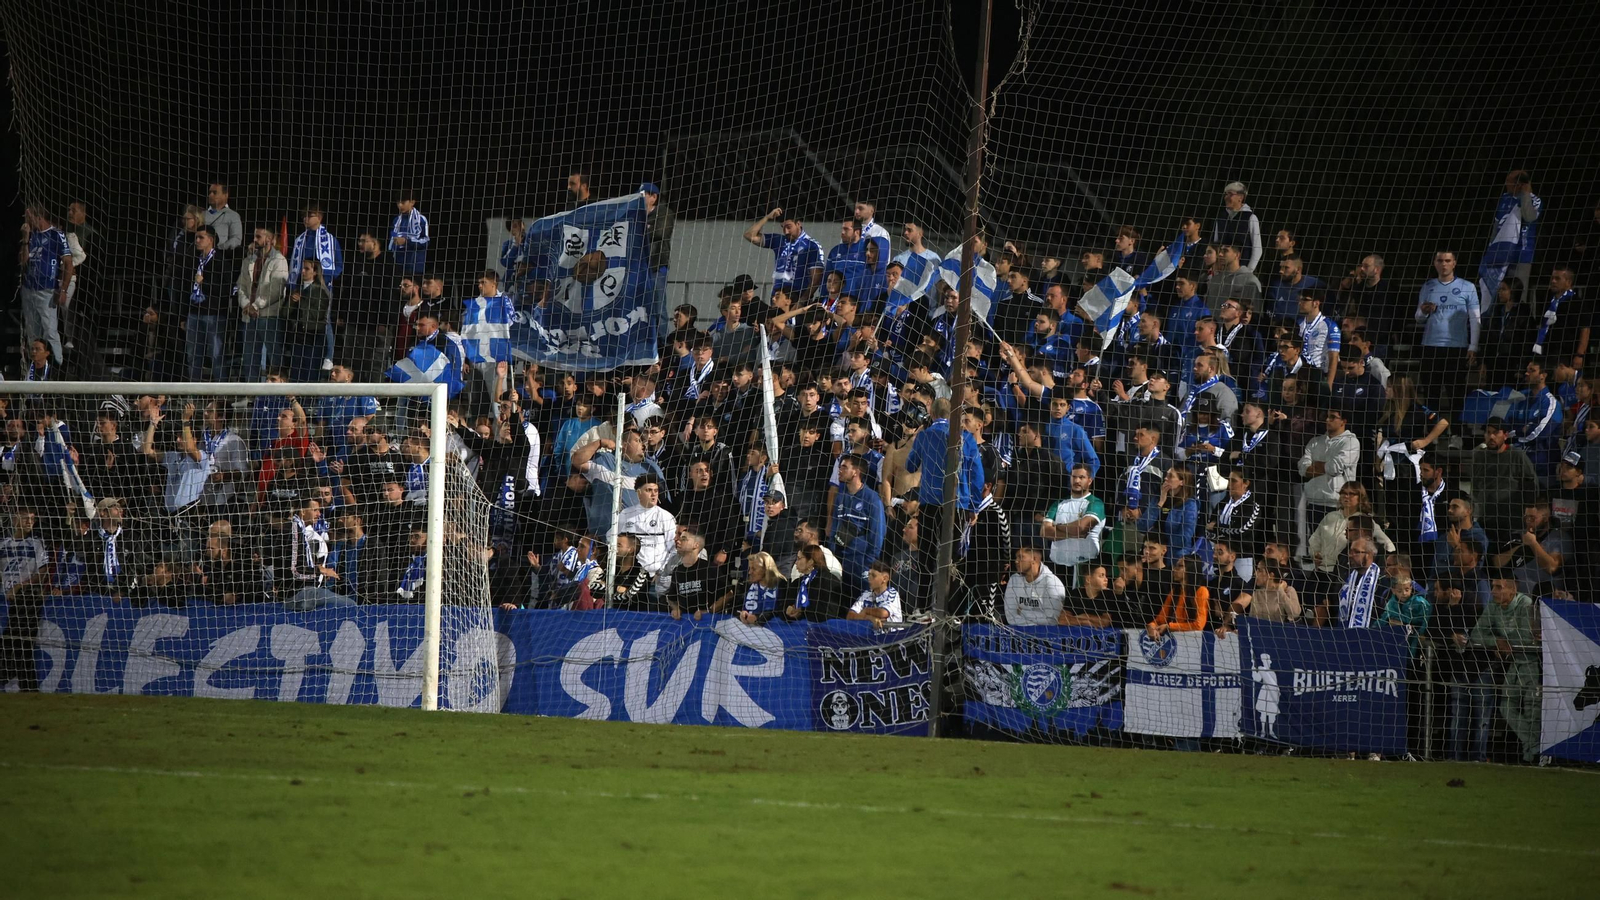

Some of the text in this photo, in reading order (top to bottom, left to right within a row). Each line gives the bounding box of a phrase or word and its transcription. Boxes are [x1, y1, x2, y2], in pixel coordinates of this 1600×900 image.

[1060, 631, 1119, 656] BOYS
[559, 618, 785, 727] SUR
[818, 635, 931, 685] NEW
[1149, 672, 1183, 687] XEREZ
[1293, 667, 1399, 698] BLUEFEATER
[1331, 694, 1357, 702] XEREZ
